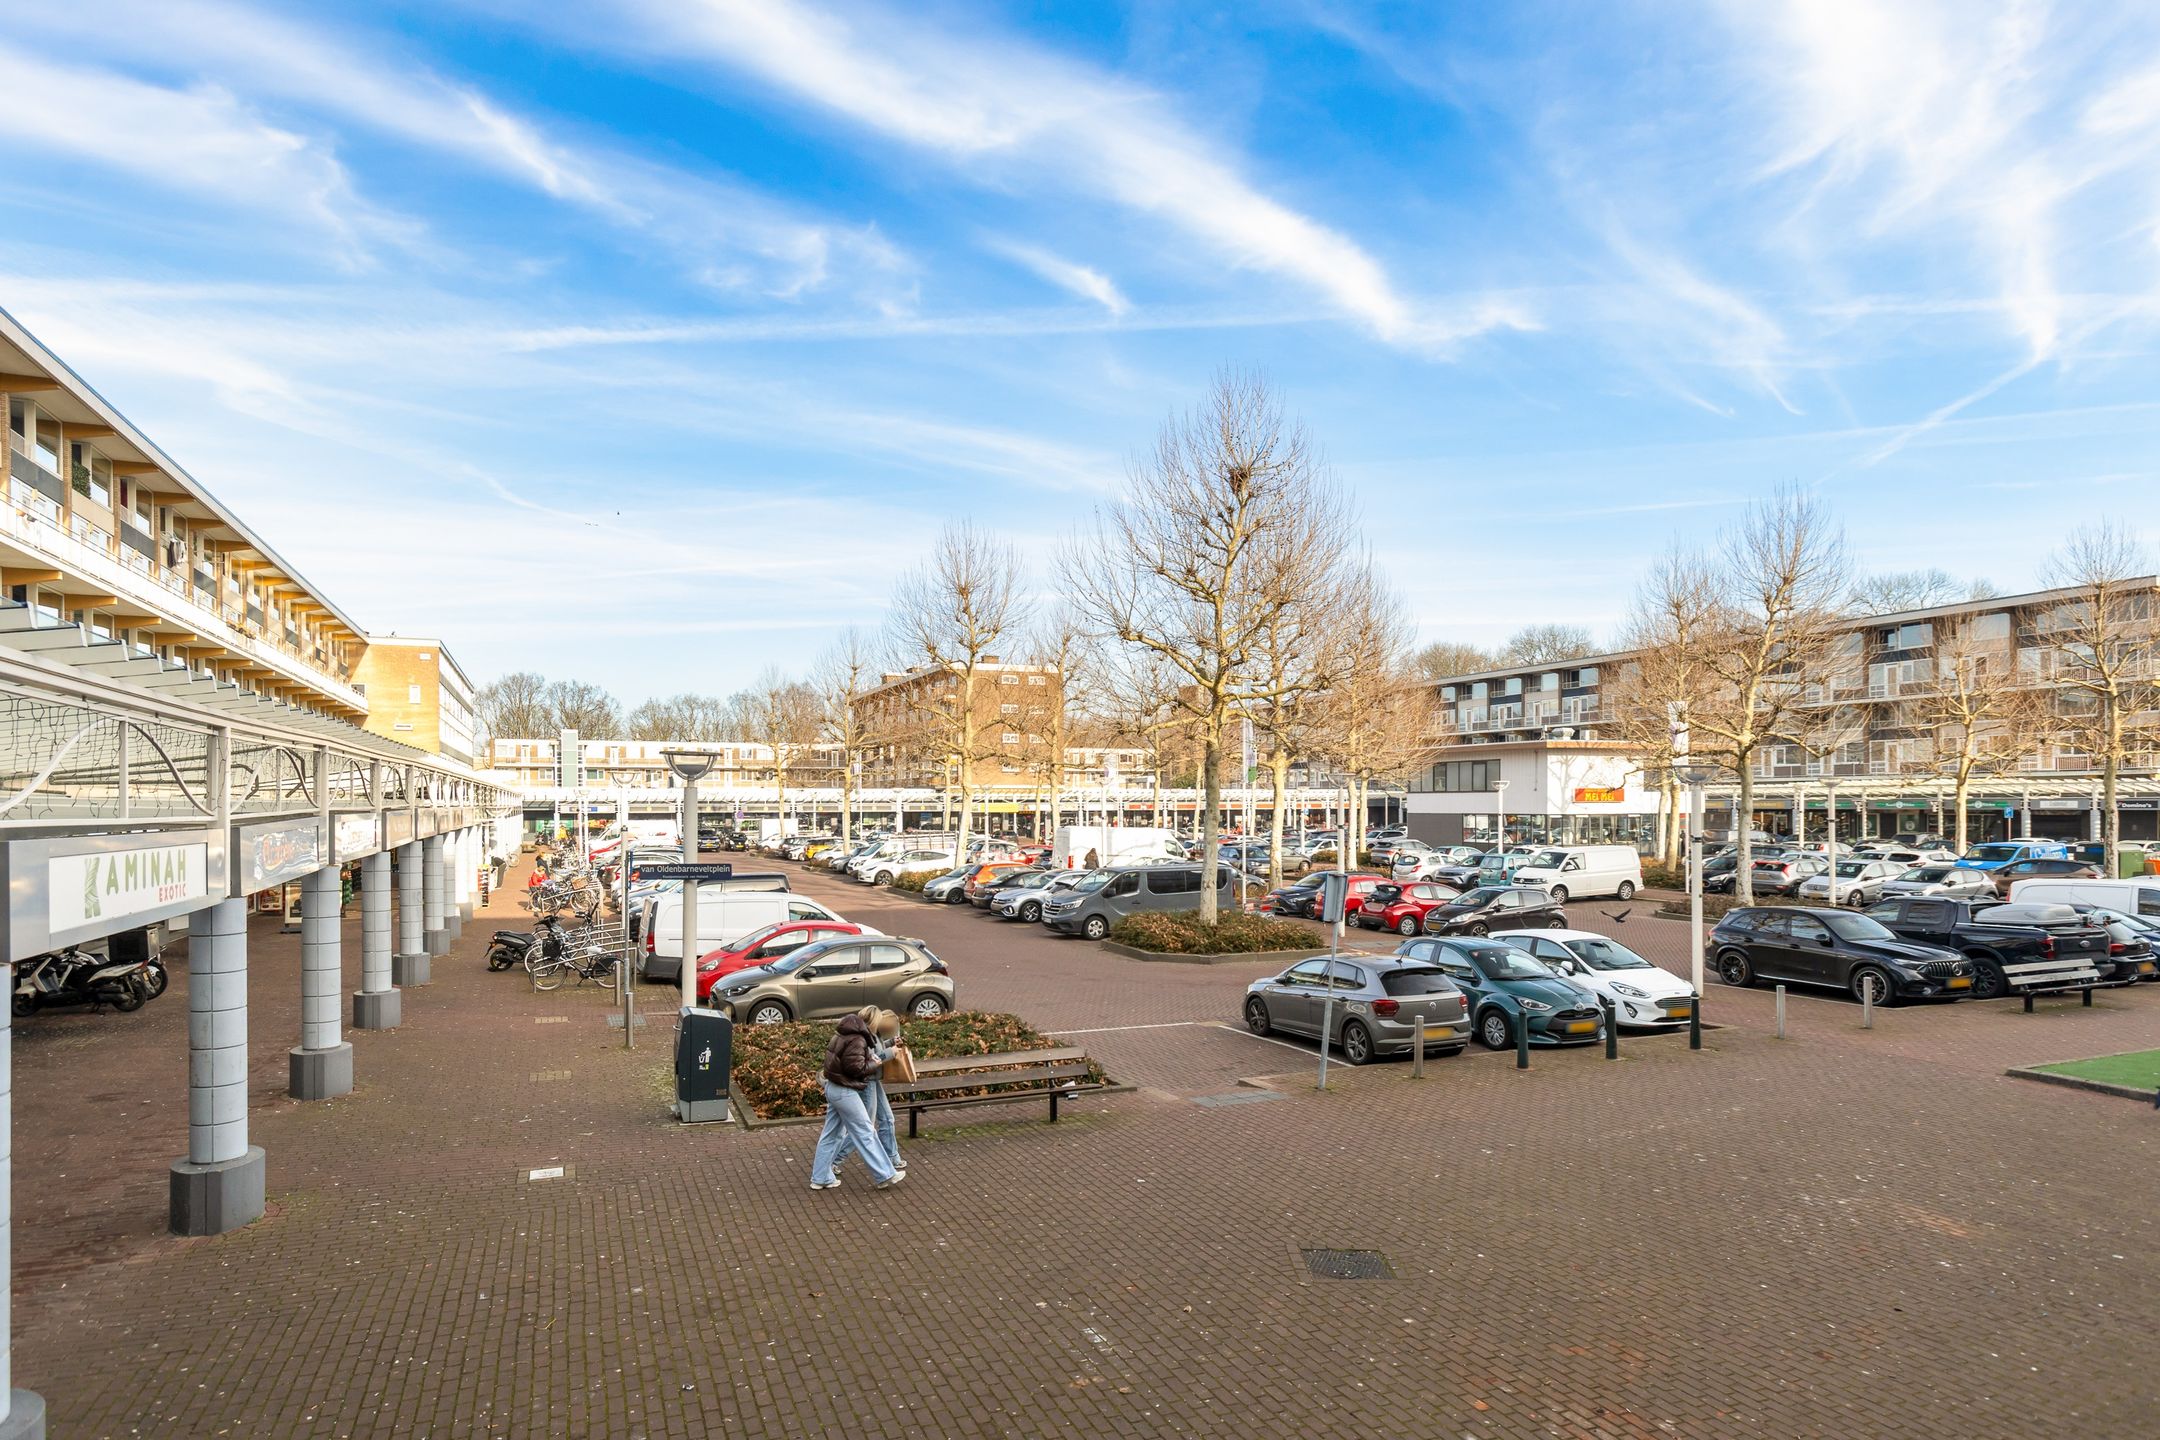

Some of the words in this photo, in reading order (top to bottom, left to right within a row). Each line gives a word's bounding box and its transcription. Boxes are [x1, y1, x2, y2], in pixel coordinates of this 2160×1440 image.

[657, 865, 731, 874] Oldenbarneveltplein
[84, 849, 186, 919] KAMINAH
[159, 883, 186, 902] EXOTIC
